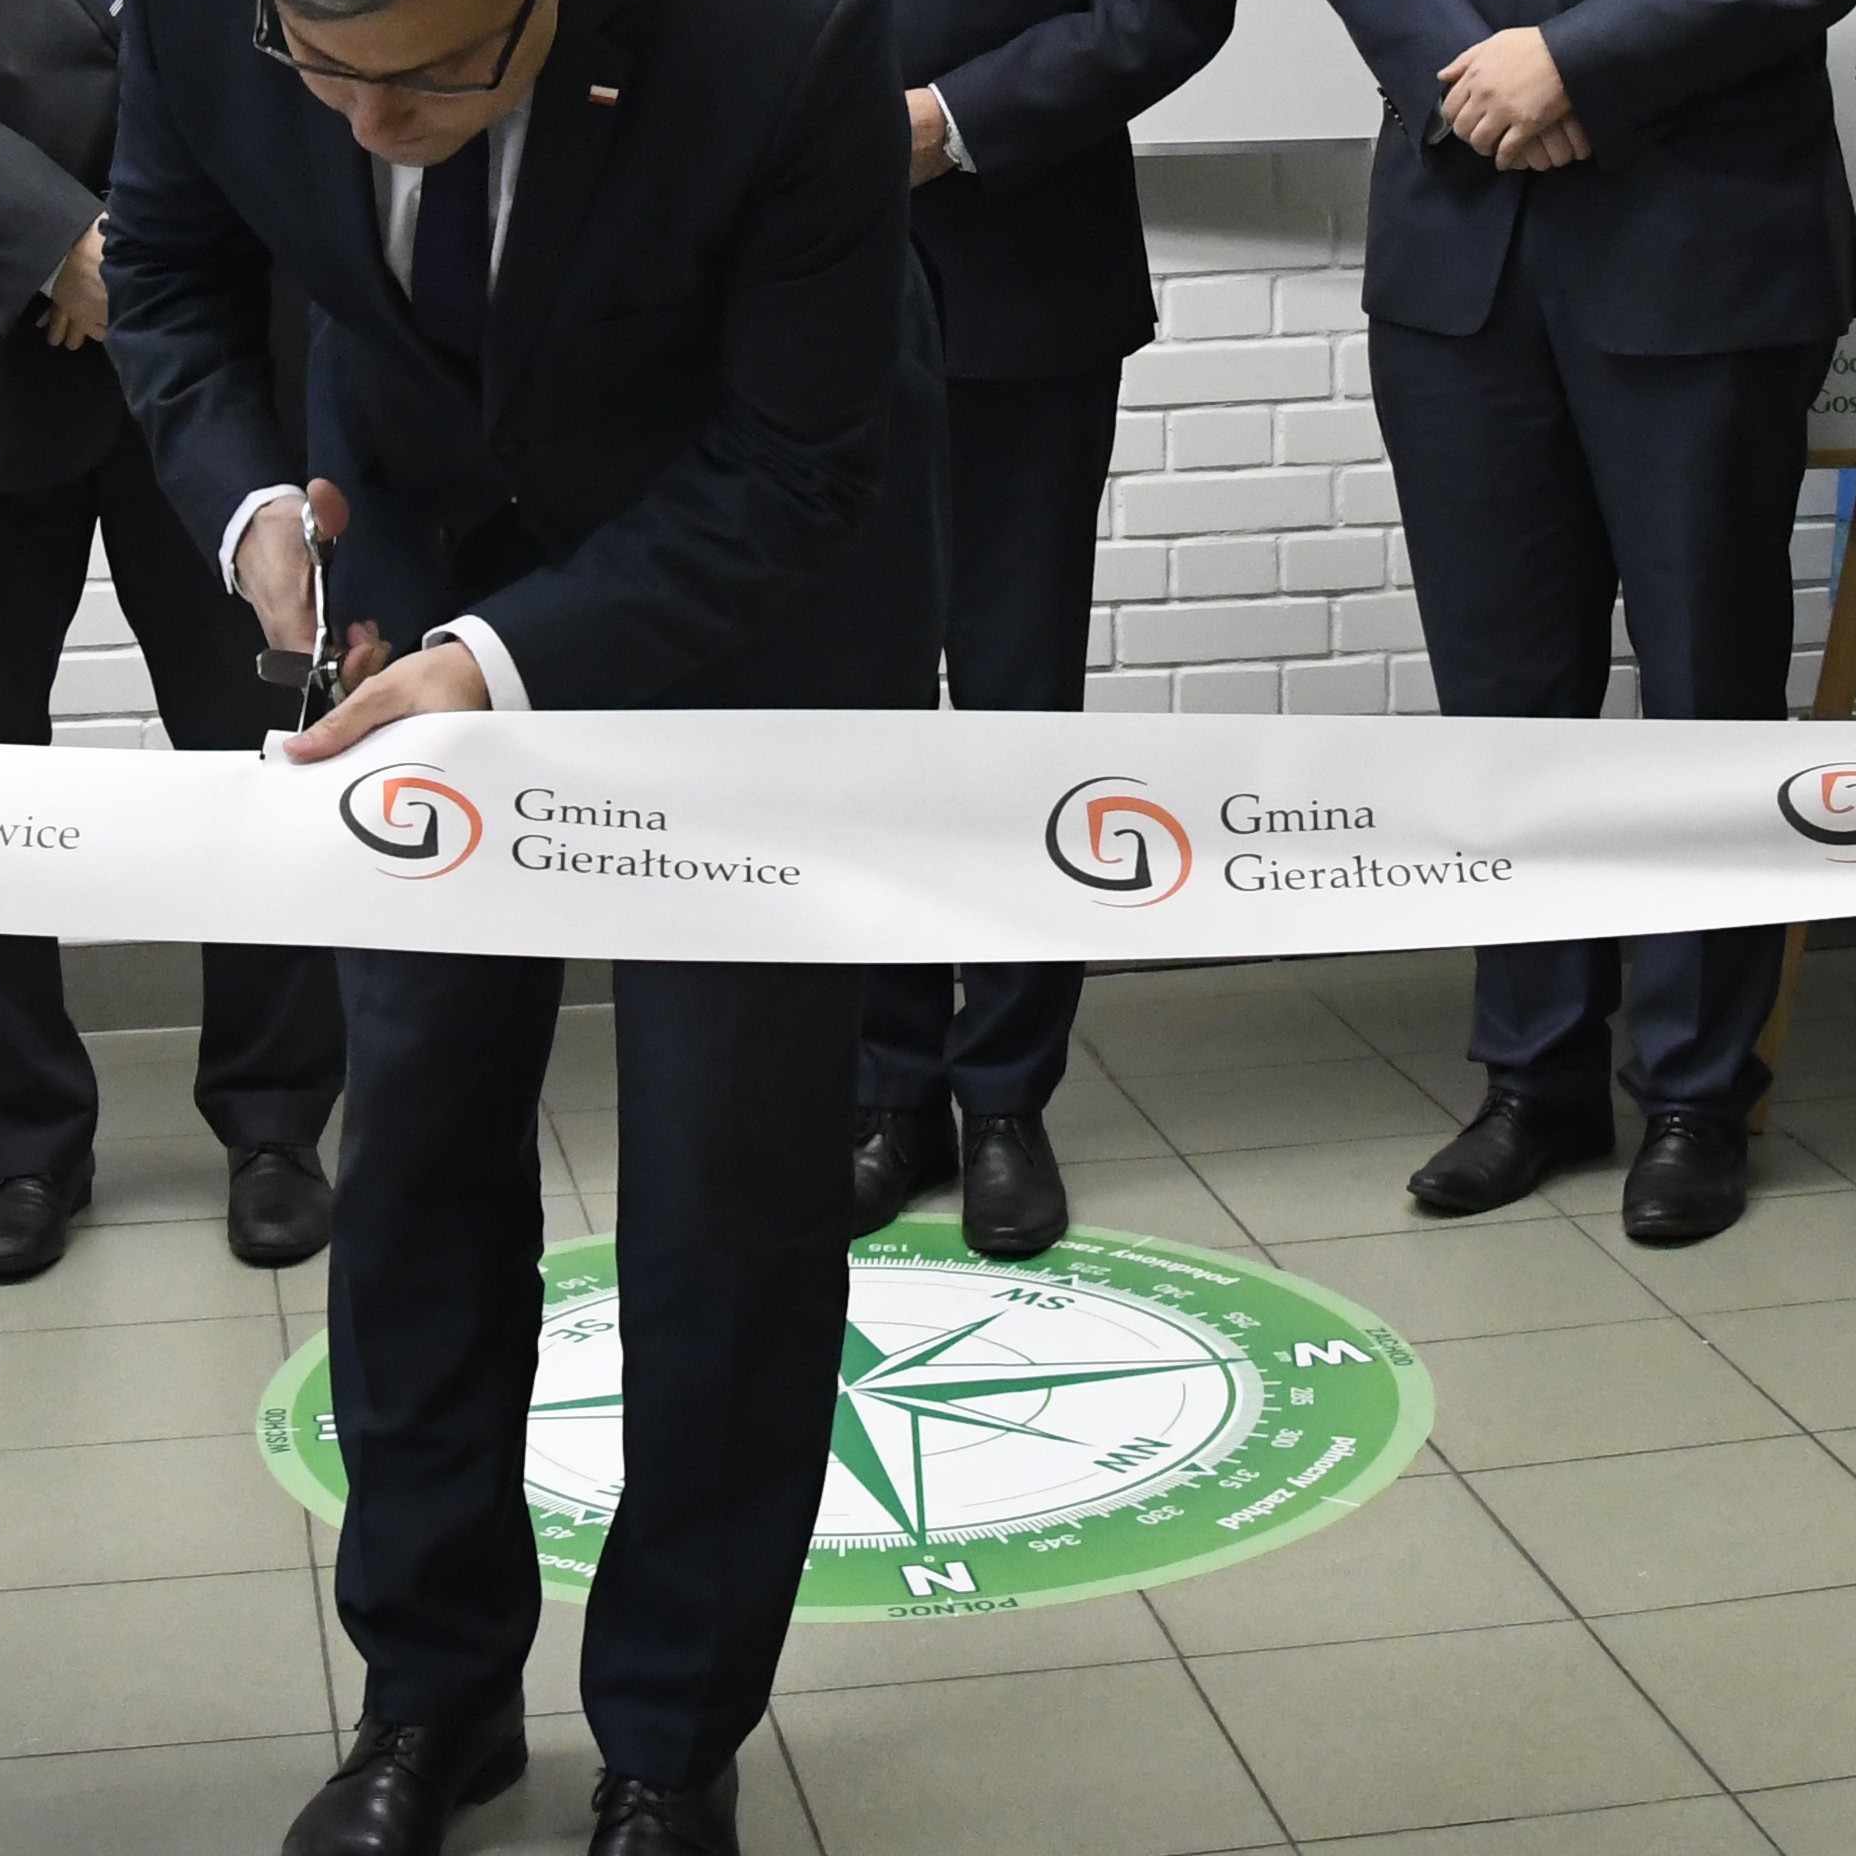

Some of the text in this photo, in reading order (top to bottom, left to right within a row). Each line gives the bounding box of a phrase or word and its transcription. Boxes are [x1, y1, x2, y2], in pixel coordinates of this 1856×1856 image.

[514, 788, 668, 831] Gmina
[1220, 793, 1376, 835] Gmina
[512, 834, 801, 886] Gierałtowice
[1224, 851, 1512, 892] Gierałtowice
[993, 1286, 1075, 1311] SW
[547, 1318, 615, 1343] SE
[1292, 1340, 1372, 1368] W
[266, 1408, 291, 1454] WSCHÓD
[1094, 1435, 1172, 1474] NW
[1137, 1504, 1184, 1525] 330
[1029, 1534, 1081, 1552] 345
[901, 1561, 978, 1595] N
[888, 1597, 1019, 1618] PÓŁNOC
